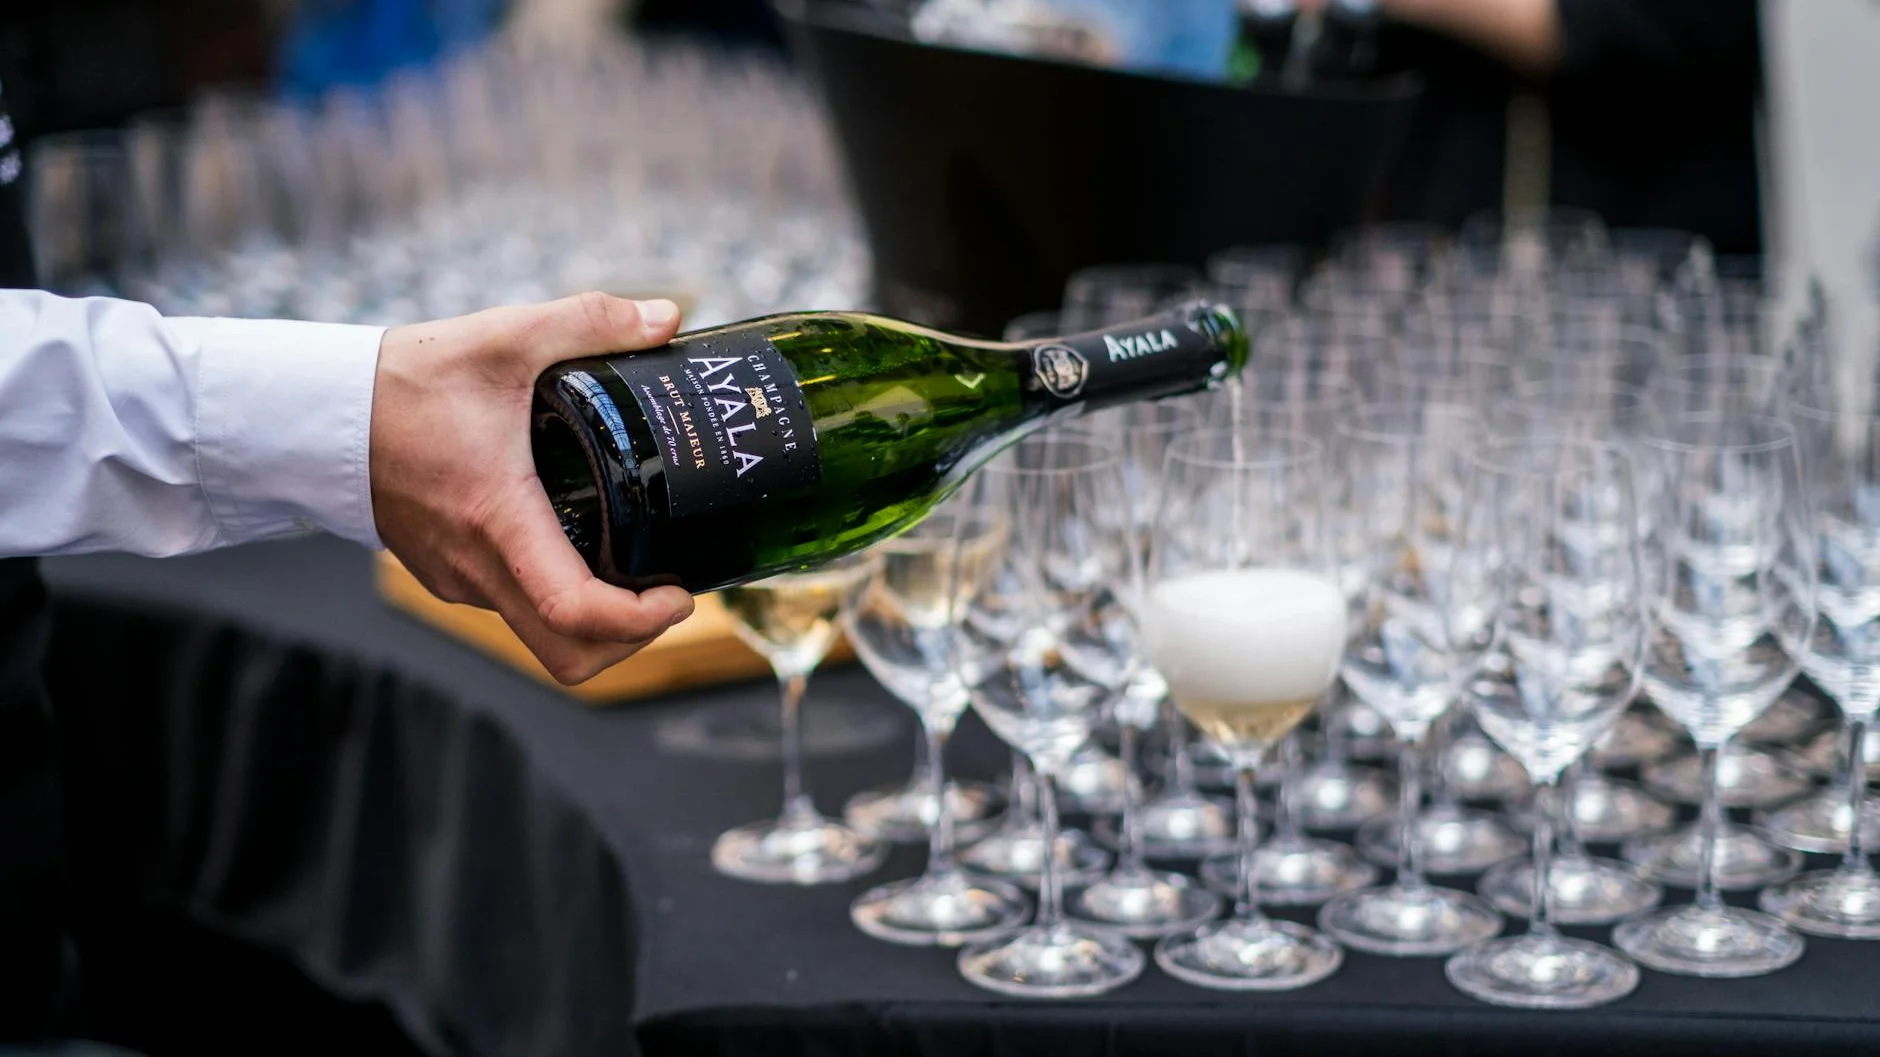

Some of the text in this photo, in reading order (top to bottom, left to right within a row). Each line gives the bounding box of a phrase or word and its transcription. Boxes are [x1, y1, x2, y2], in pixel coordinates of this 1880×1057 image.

[1103, 329, 1178, 363] AYALA
[684, 368, 705, 394] MAISON
[747, 355, 797, 451] CHAMPAGNE
[640, 384, 681, 466] Assemblage de 70 crus
[659, 375, 706, 470] BRUT MAJEUR
[687, 357, 765, 478] AYALA
[715, 431, 724, 443] EN
[719, 445, 730, 465] 1860
